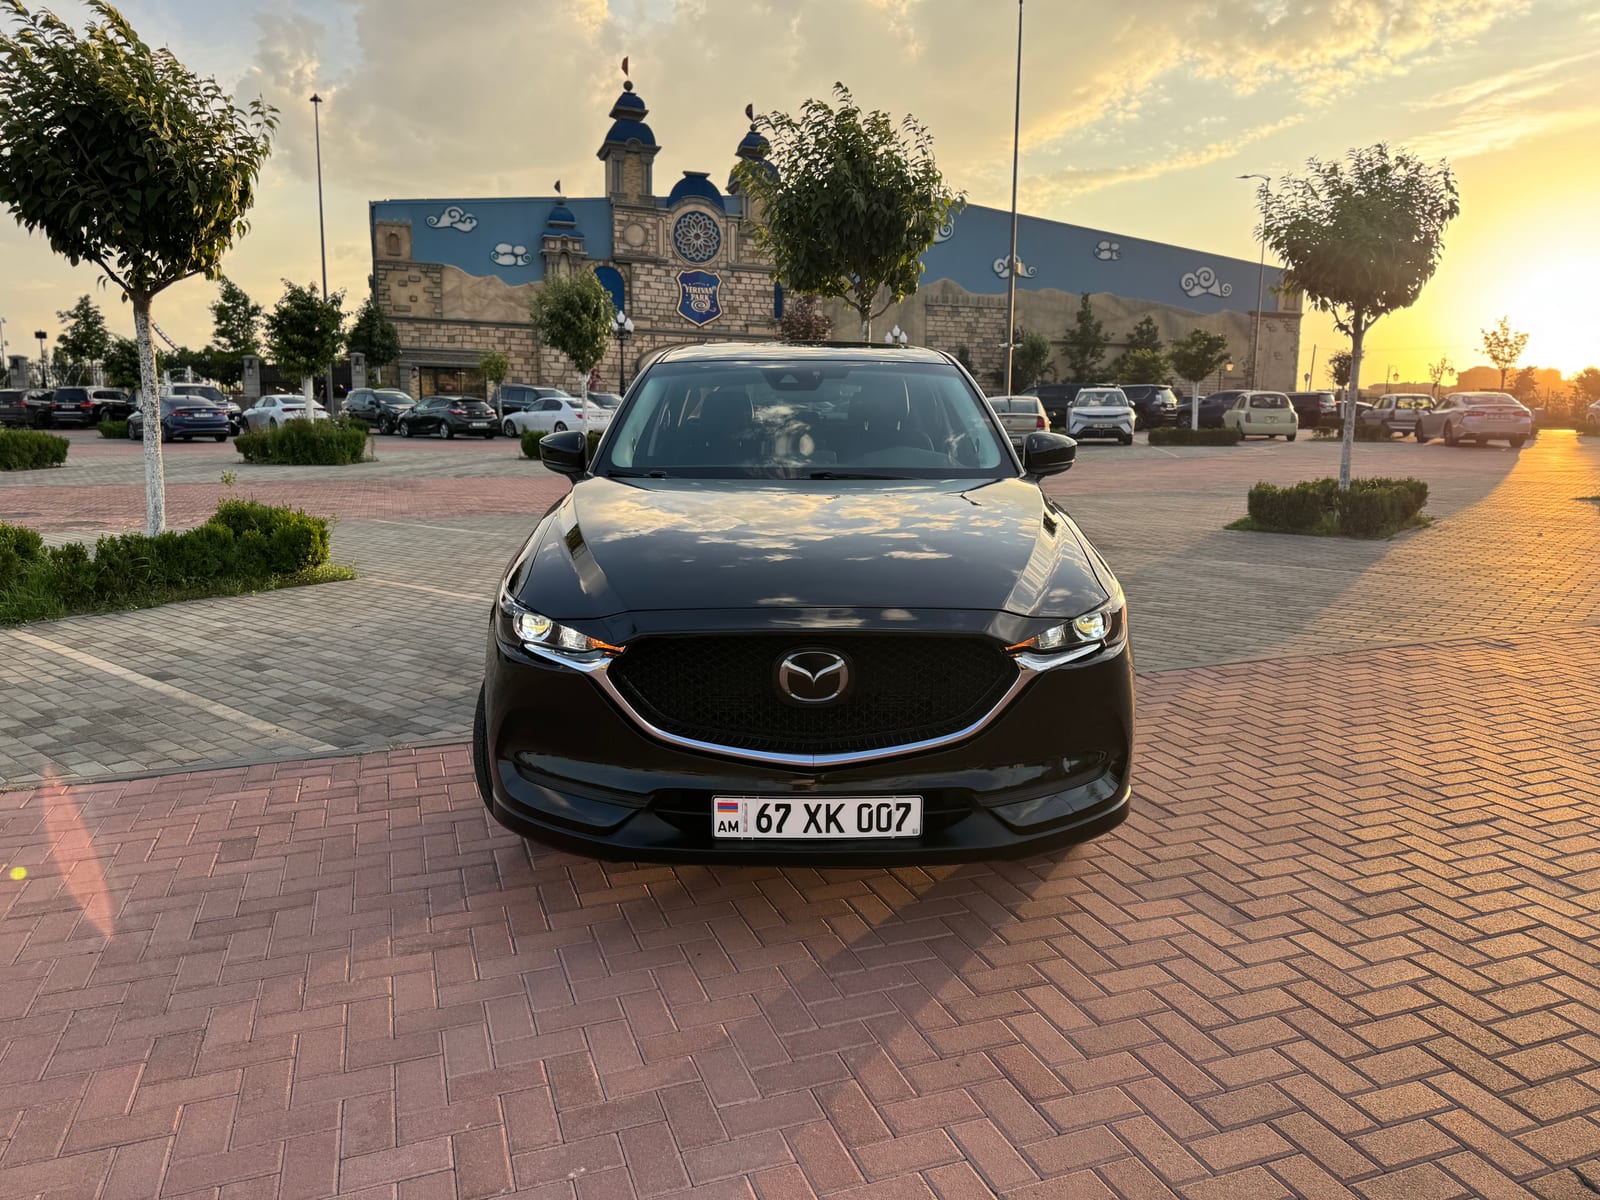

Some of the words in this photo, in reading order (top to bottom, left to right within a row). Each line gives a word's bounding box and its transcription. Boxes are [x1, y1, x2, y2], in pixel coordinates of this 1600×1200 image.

[717, 820, 739, 832] AM
[756, 803, 792, 833] 67
[803, 803, 846, 833] XK
[857, 803, 912, 833] 007
